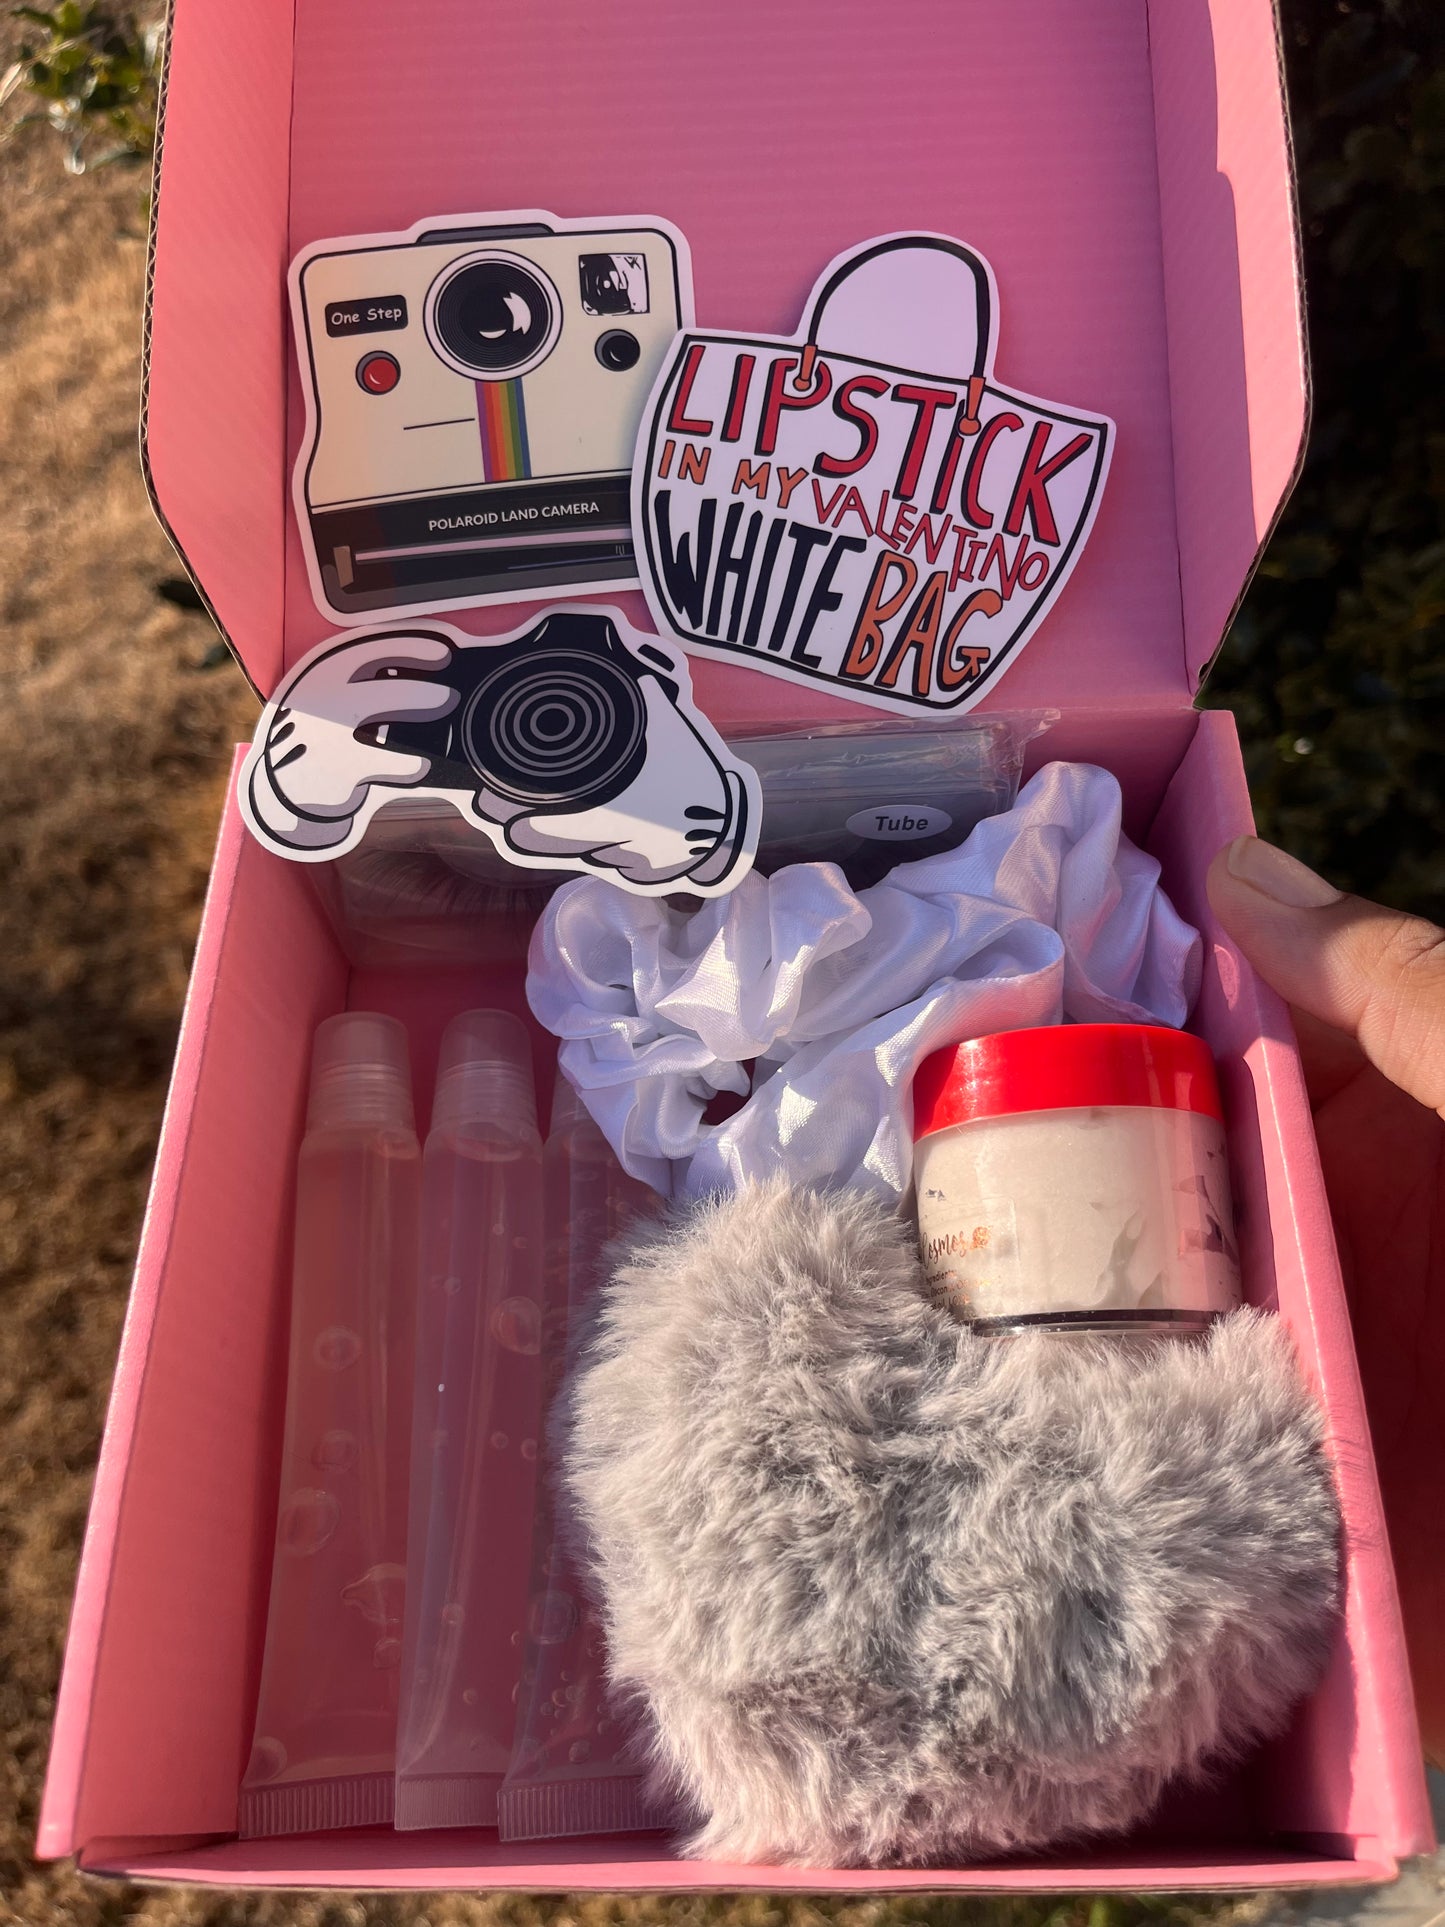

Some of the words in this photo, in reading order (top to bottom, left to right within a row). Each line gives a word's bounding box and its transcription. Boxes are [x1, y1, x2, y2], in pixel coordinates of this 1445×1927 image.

[331, 312, 361, 325] One
[366, 307, 402, 322] Step
[666, 344, 1094, 547] LIPSTICK
[428, 512, 499, 531] POLAROID
[501, 508, 539, 523] LAND
[541, 501, 600, 518] CAMERA
[658, 440, 712, 485] IN
[731, 458, 810, 509] MY
[811, 478, 1050, 601] VALENTINO
[654, 489, 867, 667] WHITE
[837, 549, 1003, 696] BAG
[874, 815, 929, 832] Tube
